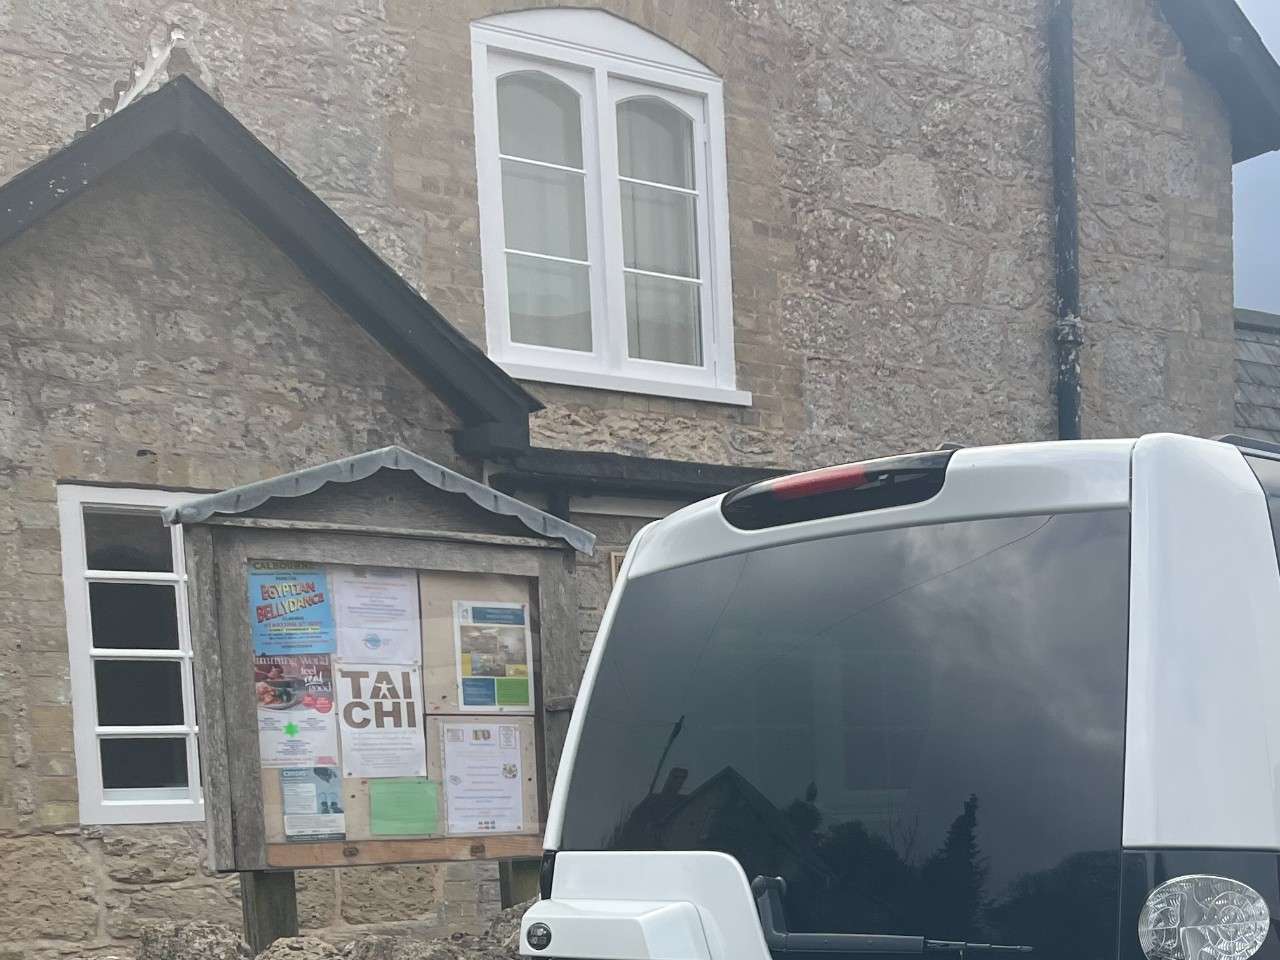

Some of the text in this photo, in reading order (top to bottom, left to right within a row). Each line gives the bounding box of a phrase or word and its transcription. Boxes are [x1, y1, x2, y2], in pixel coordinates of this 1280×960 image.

[261, 582, 316, 600] EGYPTIAN
[256, 592, 324, 623] BELLYDANCE
[341, 671, 412, 699] TAI
[343, 701, 416, 728] CHI
